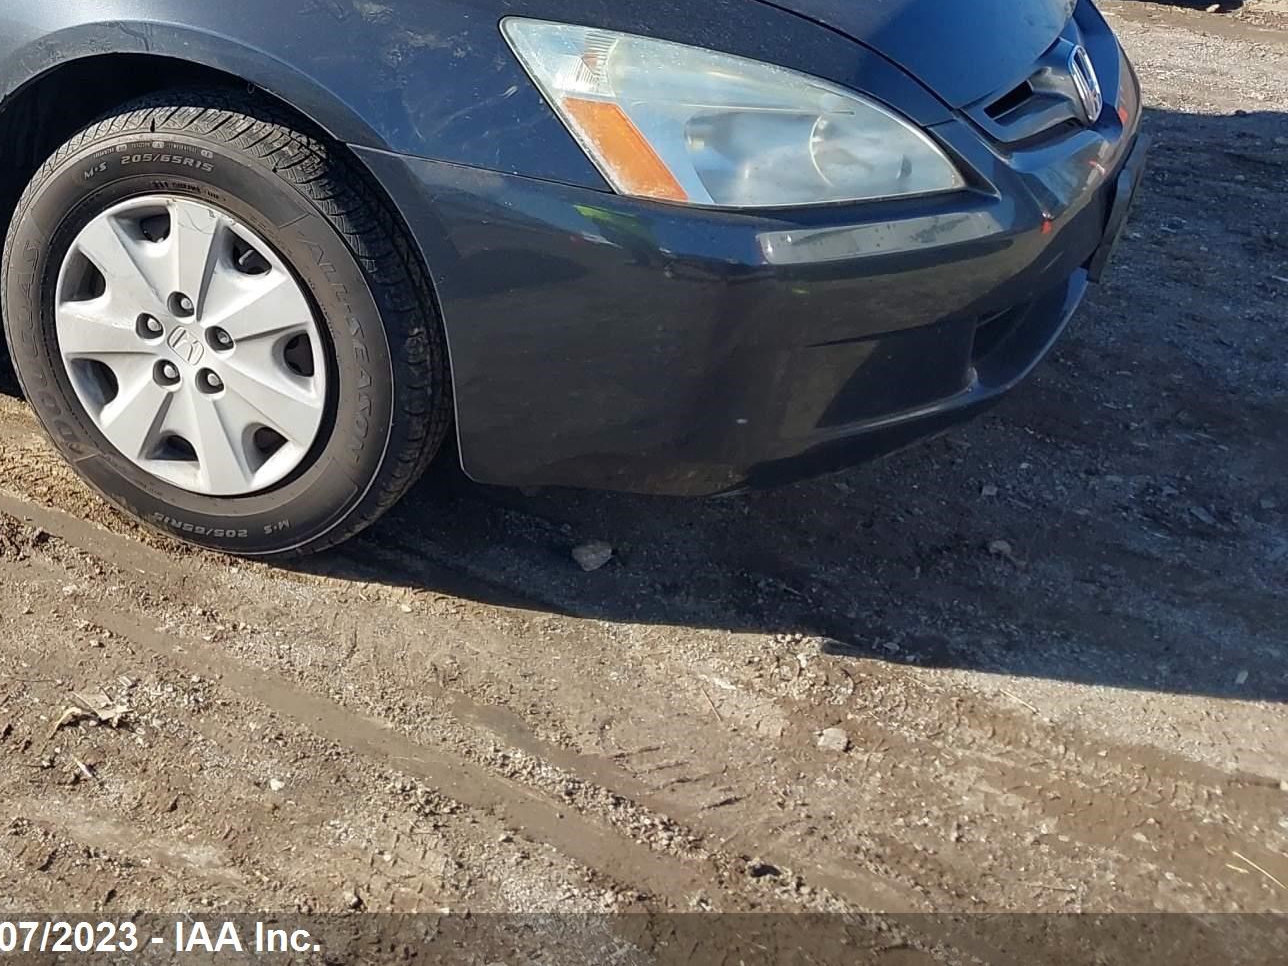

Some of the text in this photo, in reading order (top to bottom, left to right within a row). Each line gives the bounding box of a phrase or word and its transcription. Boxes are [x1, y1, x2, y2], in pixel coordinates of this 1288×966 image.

[120, 153, 215, 173] 205/65R15
[296, 234, 372, 463] ALL-SEASON
[153, 511, 249, 538] 205/65R15
